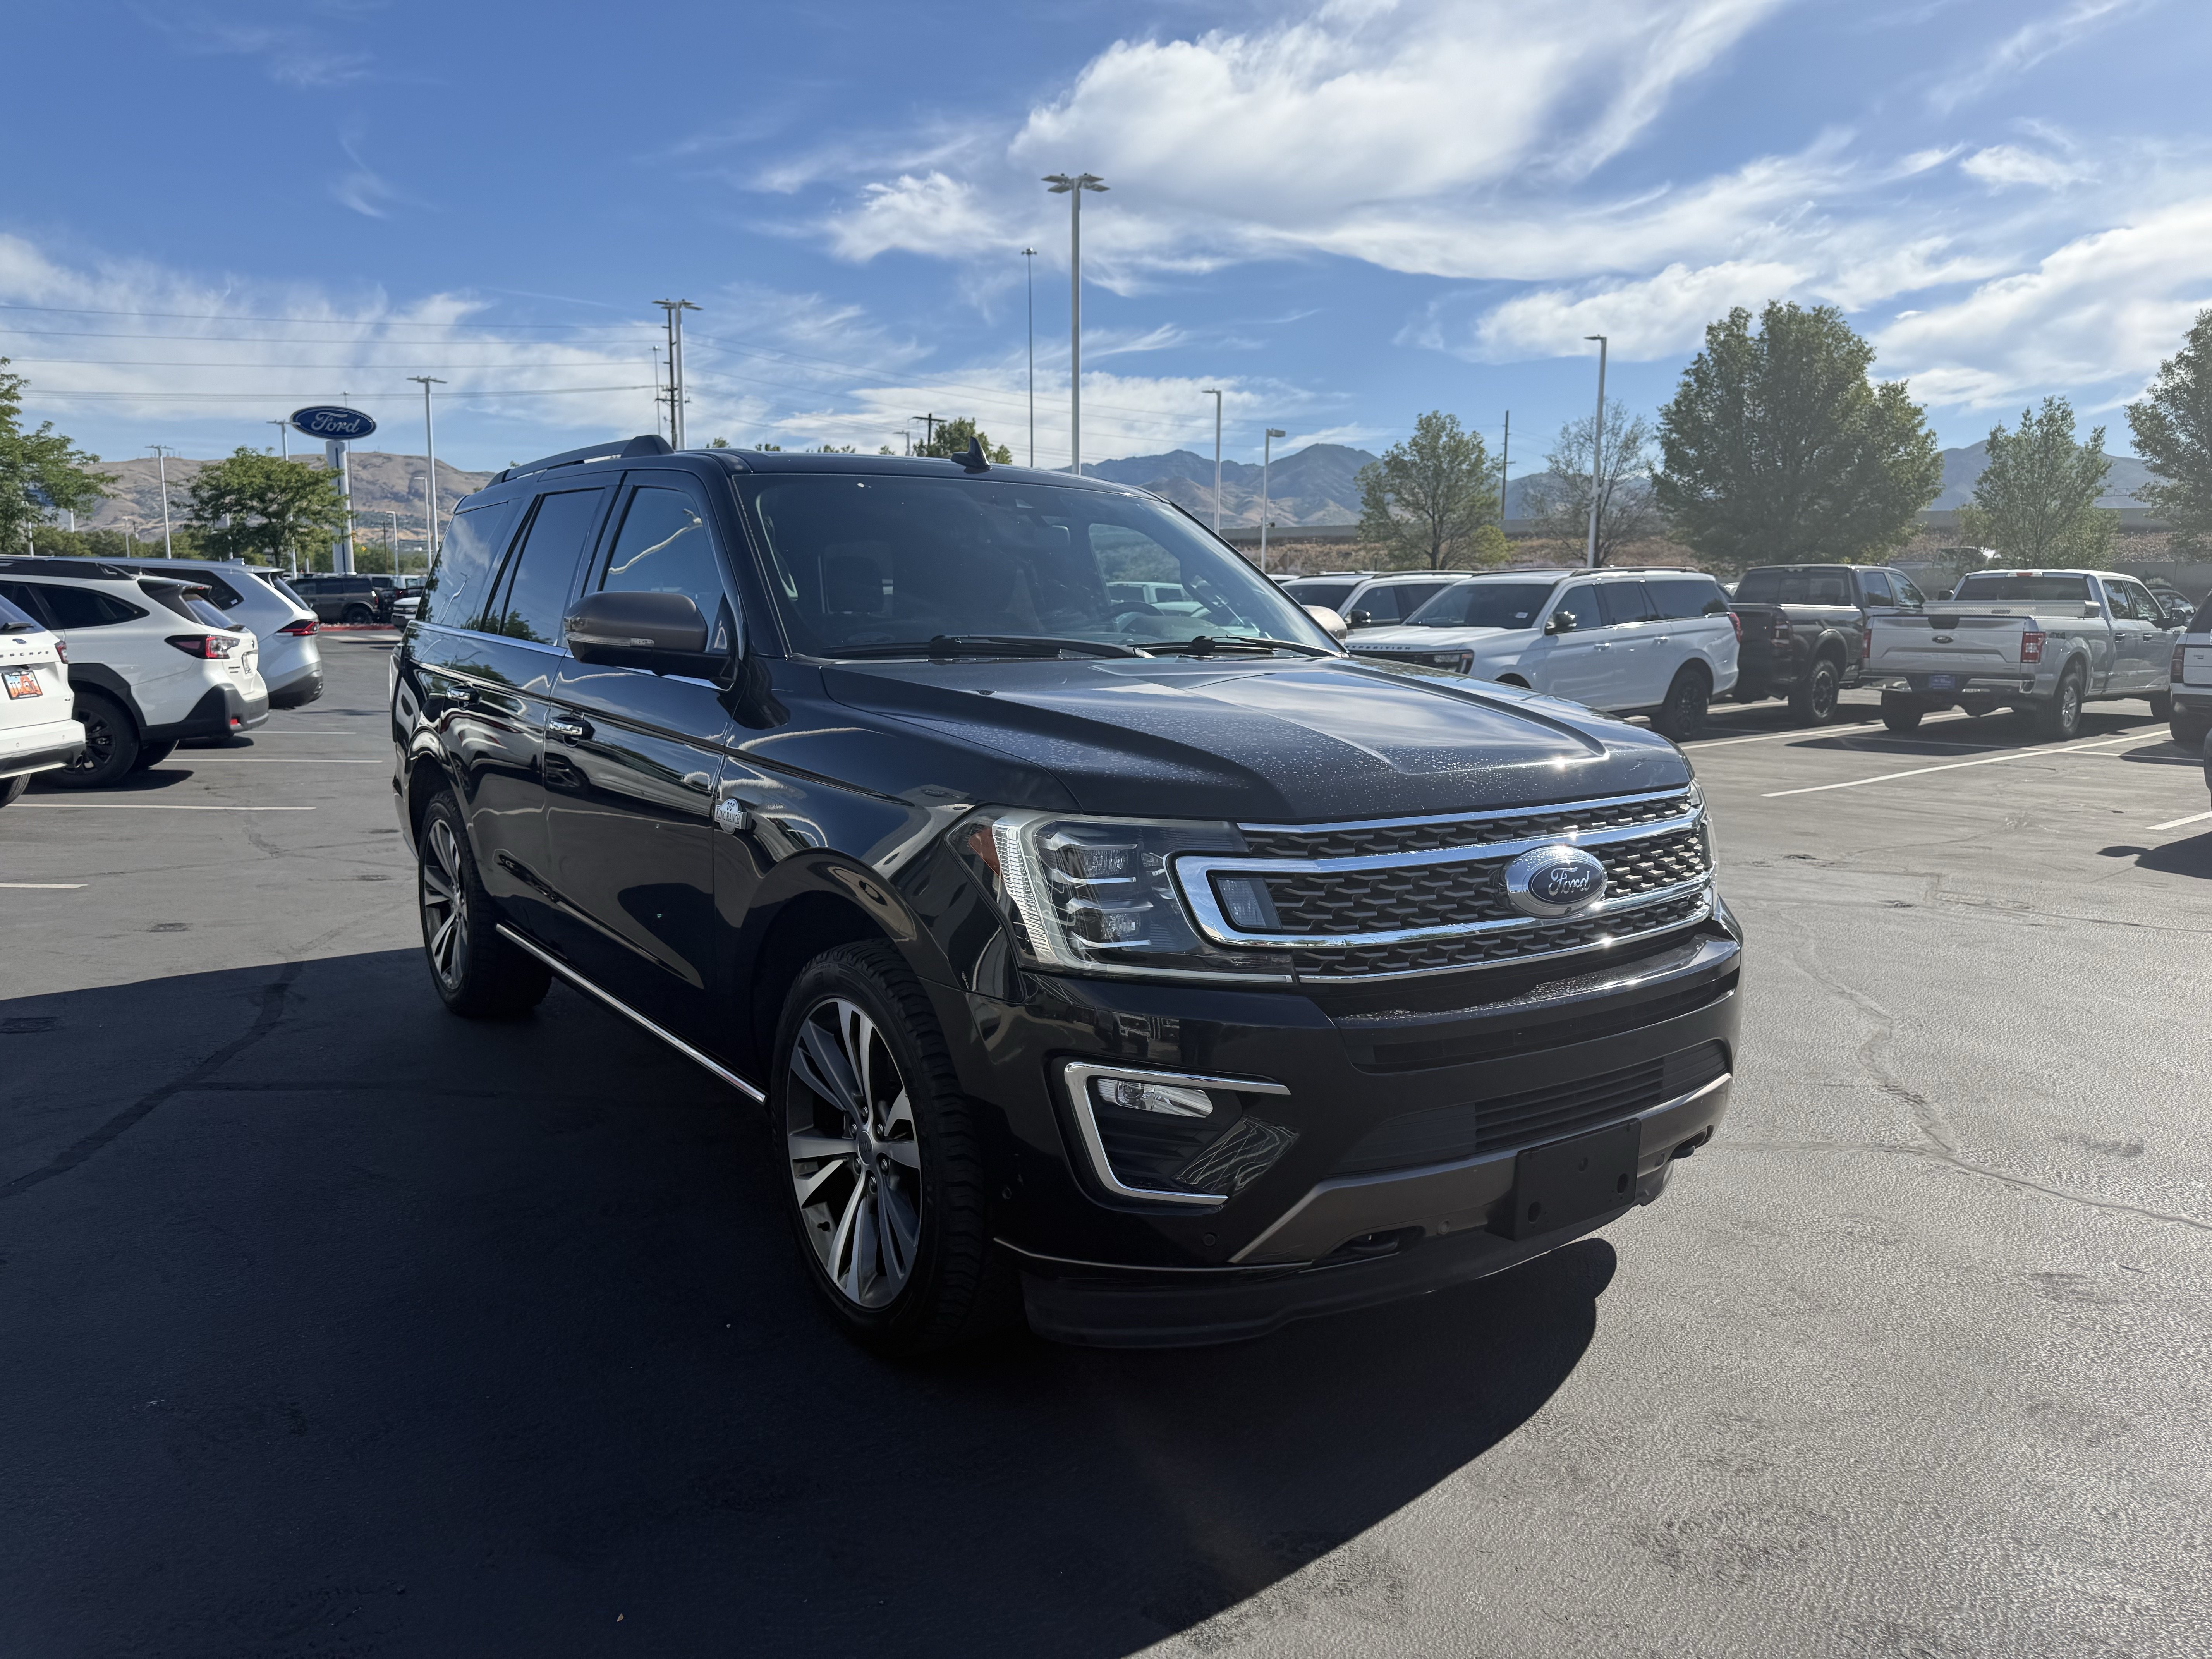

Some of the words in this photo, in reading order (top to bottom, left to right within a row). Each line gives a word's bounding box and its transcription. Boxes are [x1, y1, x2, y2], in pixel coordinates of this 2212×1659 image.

[311, 412, 360, 433] Ford
[716, 807, 726, 821] KING
[726, 812, 741, 825] RANCH
[1549, 866, 1591, 896] Ford
